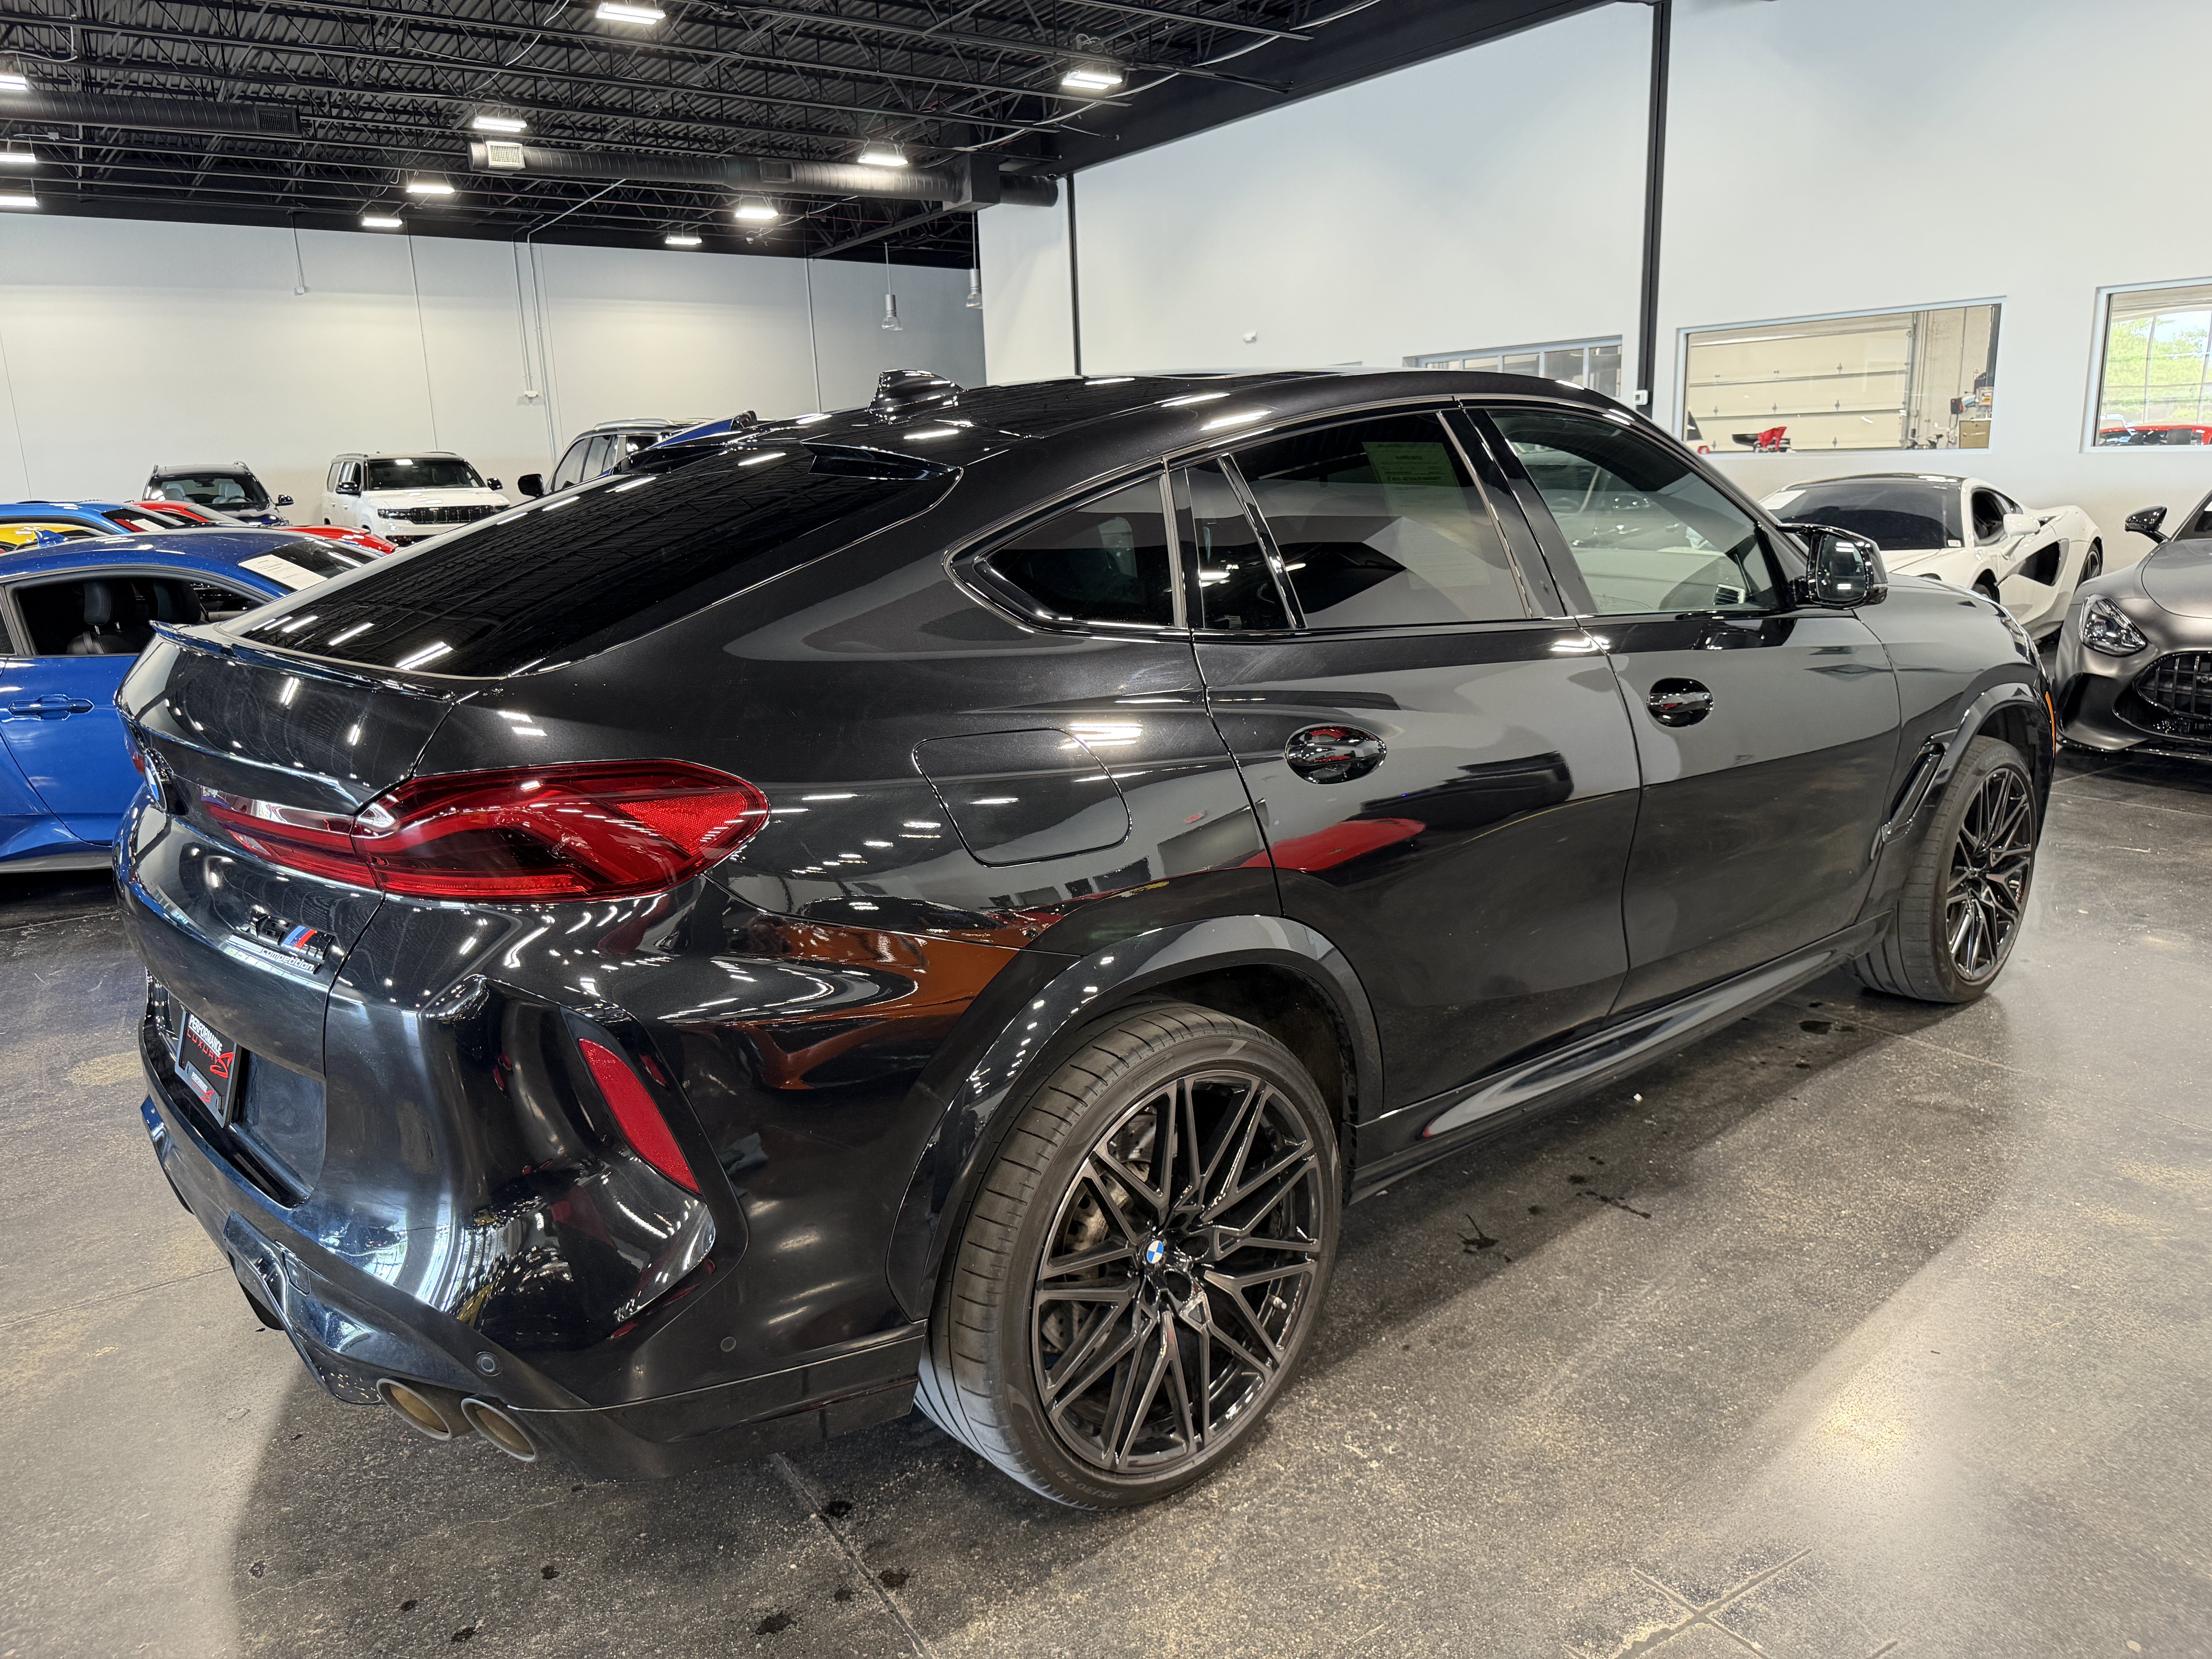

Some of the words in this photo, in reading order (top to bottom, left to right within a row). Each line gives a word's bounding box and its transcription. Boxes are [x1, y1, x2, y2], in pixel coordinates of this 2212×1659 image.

[261, 948, 315, 971] competition
[186, 1029, 219, 1064] LUXURY
[189, 1014, 223, 1056] PERFORMANCE
